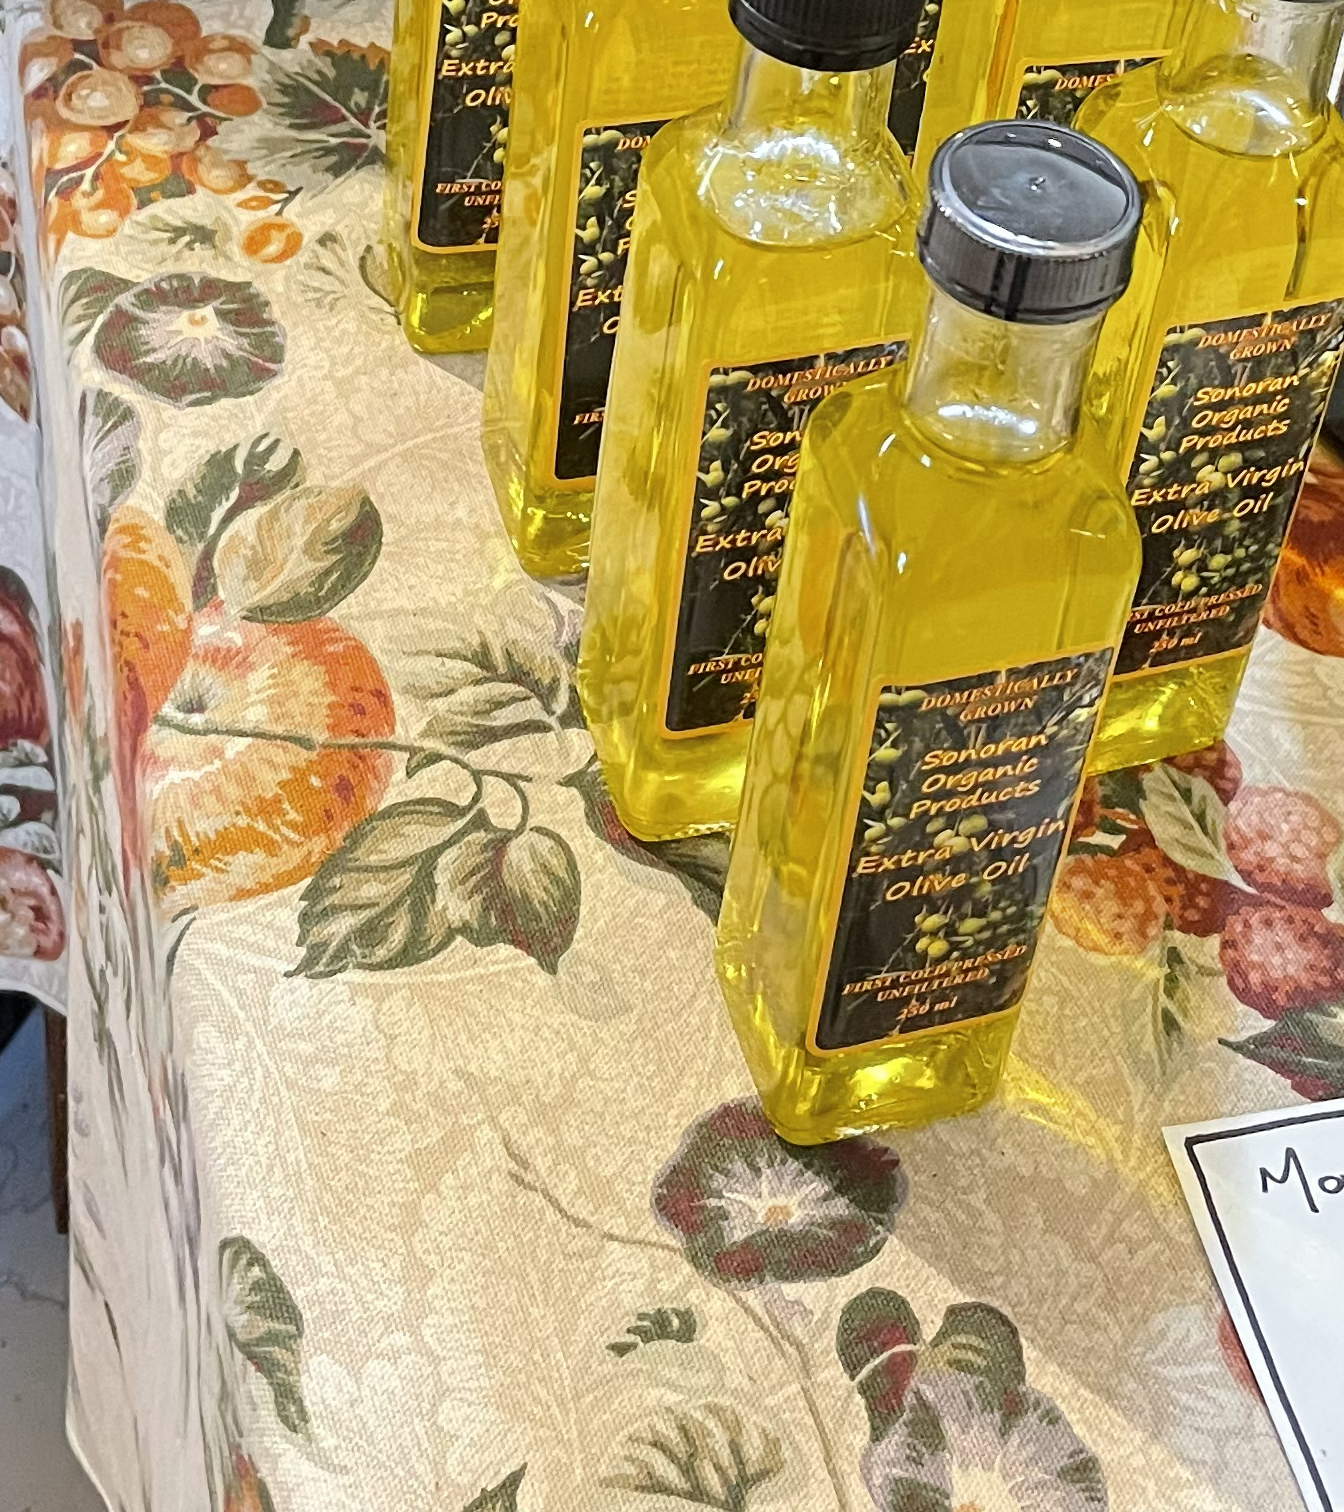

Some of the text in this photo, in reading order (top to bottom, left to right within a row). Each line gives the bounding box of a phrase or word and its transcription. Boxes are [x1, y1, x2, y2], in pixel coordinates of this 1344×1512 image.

[465, 86, 513, 108] Oliv
[435, 181, 502, 194] FIRST CO
[574, 285, 623, 308] Ext
[1197, 312, 1331, 349] DOMESTICALLY
[1229, 336, 1296, 361] GROWN
[747, 356, 892, 393] DOMESTICALLY
[1194, 372, 1300, 406] Sonoran
[783, 382, 847, 404] GROW
[1191, 395, 1290, 429] Organic
[1179, 419, 1290, 454] Products
[1131, 457, 1306, 507] Extra Virgin
[1151, 492, 1274, 534] Olive Oil
[695, 528, 782, 554] Extra
[723, 557, 781, 582] Oliv
[1155, 583, 1263, 618] COLD PRESSED
[1134, 605, 1230, 634] UNFILTERED
[1181, 632, 1201, 646] ml
[688, 659, 734, 676] FIRST
[739, 653, 763, 668] CO
[919, 667, 1078, 713] DOMESTICALLY
[959, 695, 1038, 724] GROWN
[921, 730, 1050, 769] Sonoran
[921, 755, 1040, 794] Organic
[909, 777, 1041, 820] Products
[856, 818, 1066, 877] Extra Virgin
[886, 852, 1030, 903] Olive Oil
[843, 944, 1027, 997] FIRST COLD PRESSED
[877, 967, 990, 1004] UNFILTERED
[935, 995, 957, 1013] ml
